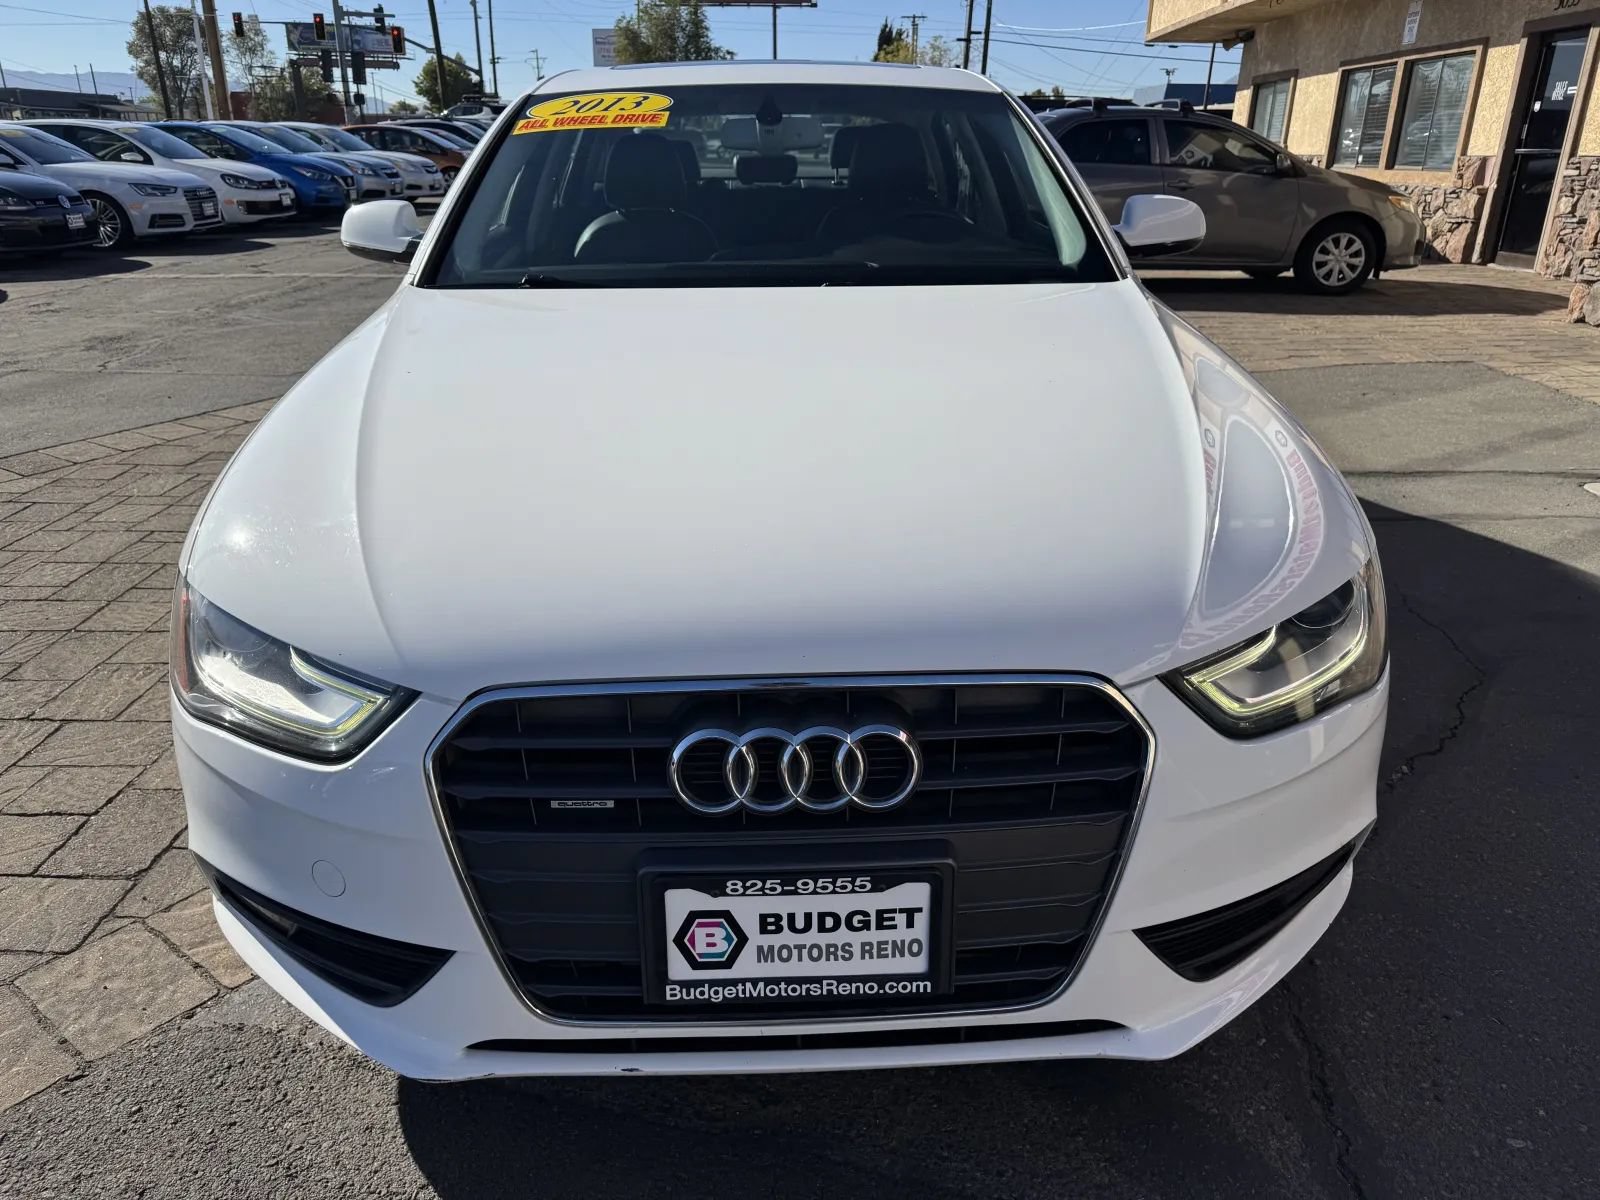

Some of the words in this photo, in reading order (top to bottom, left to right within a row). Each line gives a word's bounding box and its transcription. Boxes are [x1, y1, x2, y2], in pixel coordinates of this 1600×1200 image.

[549, 95, 651, 116] 2013
[517, 118, 549, 131] ALL
[553, 114, 609, 127] WHEEL
[610, 112, 664, 124] DRIVE
[725, 876, 872, 895] 825-9555
[758, 906, 923, 935] BUDGET
[694, 927, 729, 954] B
[756, 942, 854, 964] MOTORS
[860, 938, 924, 961] RENO
[665, 979, 932, 1002] BudgetMotorsReno.com
